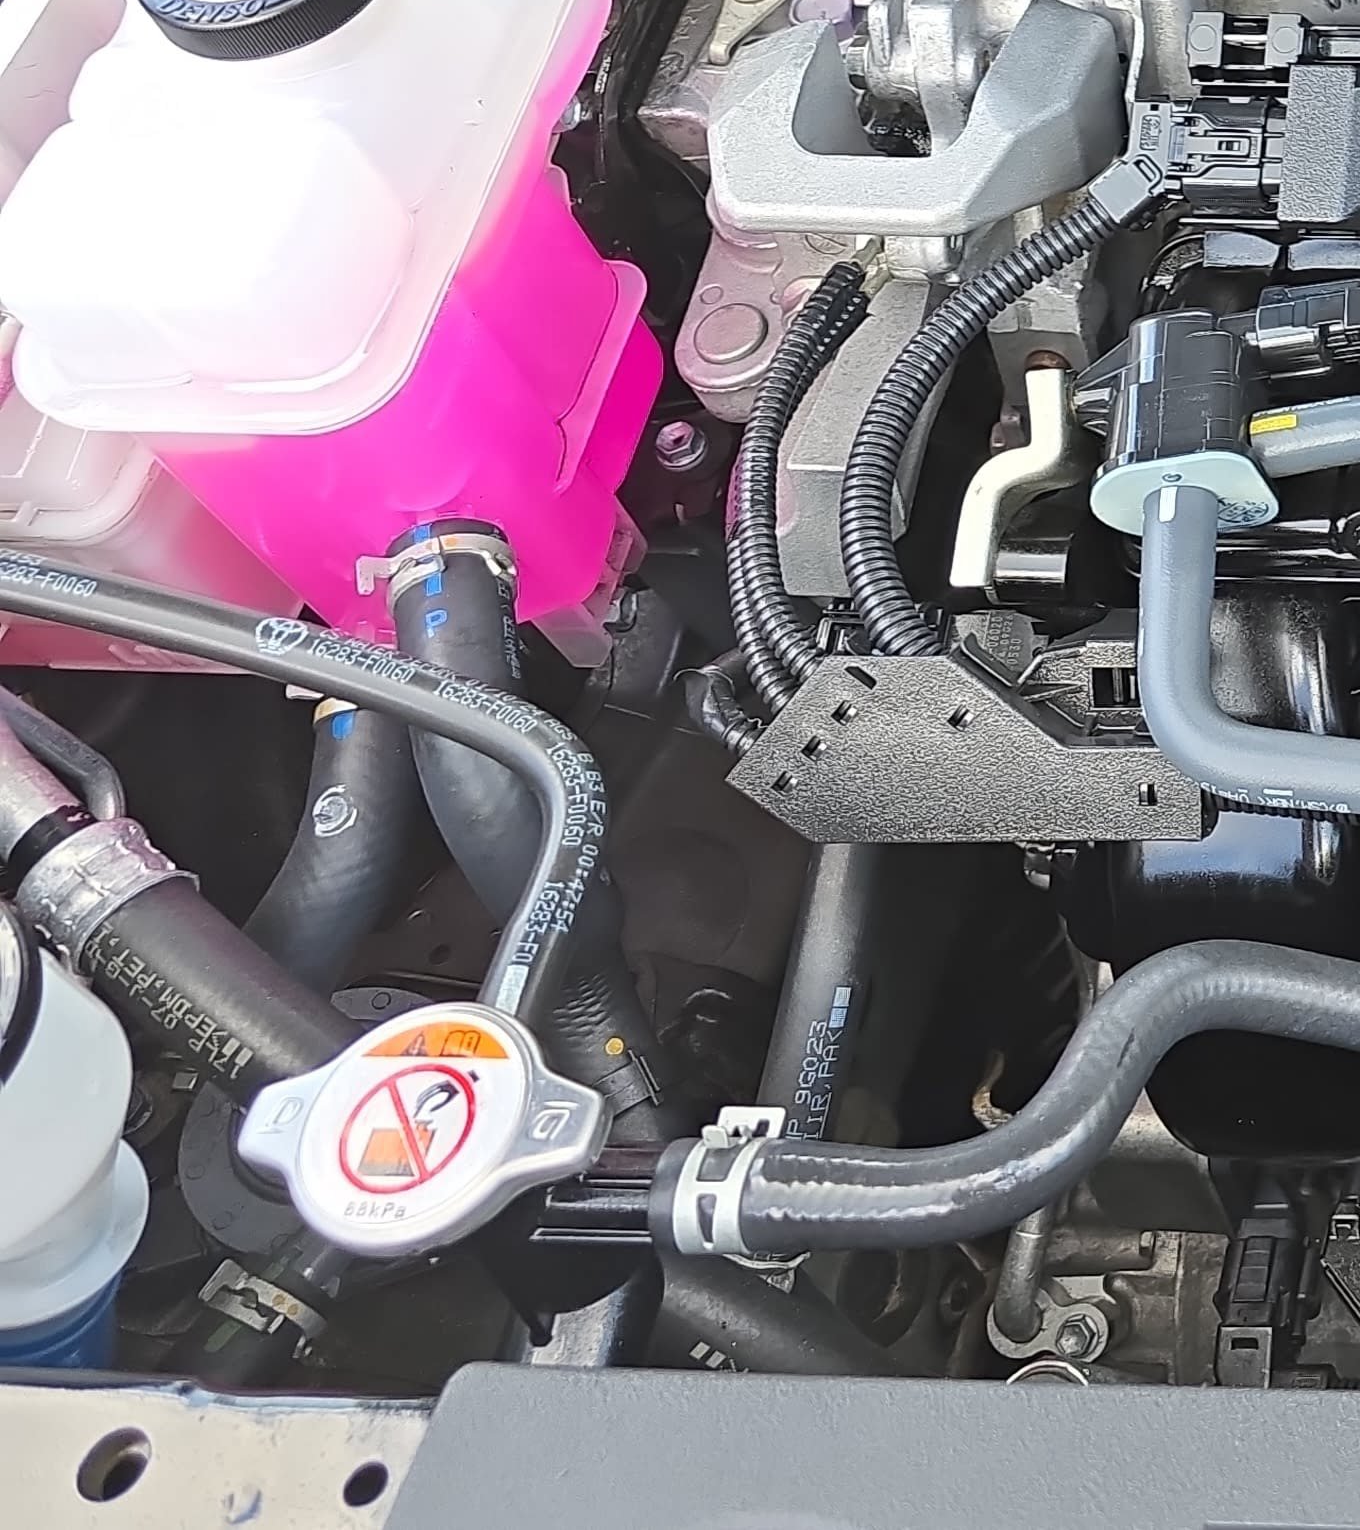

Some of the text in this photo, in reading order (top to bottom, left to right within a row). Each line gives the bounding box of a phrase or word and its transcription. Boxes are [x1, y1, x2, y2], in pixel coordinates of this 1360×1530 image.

[307, 638, 416, 684] 16283-F0060
[431, 680, 539, 735] 16283-F0060
[546, 740, 589, 848] 16283-F0060
